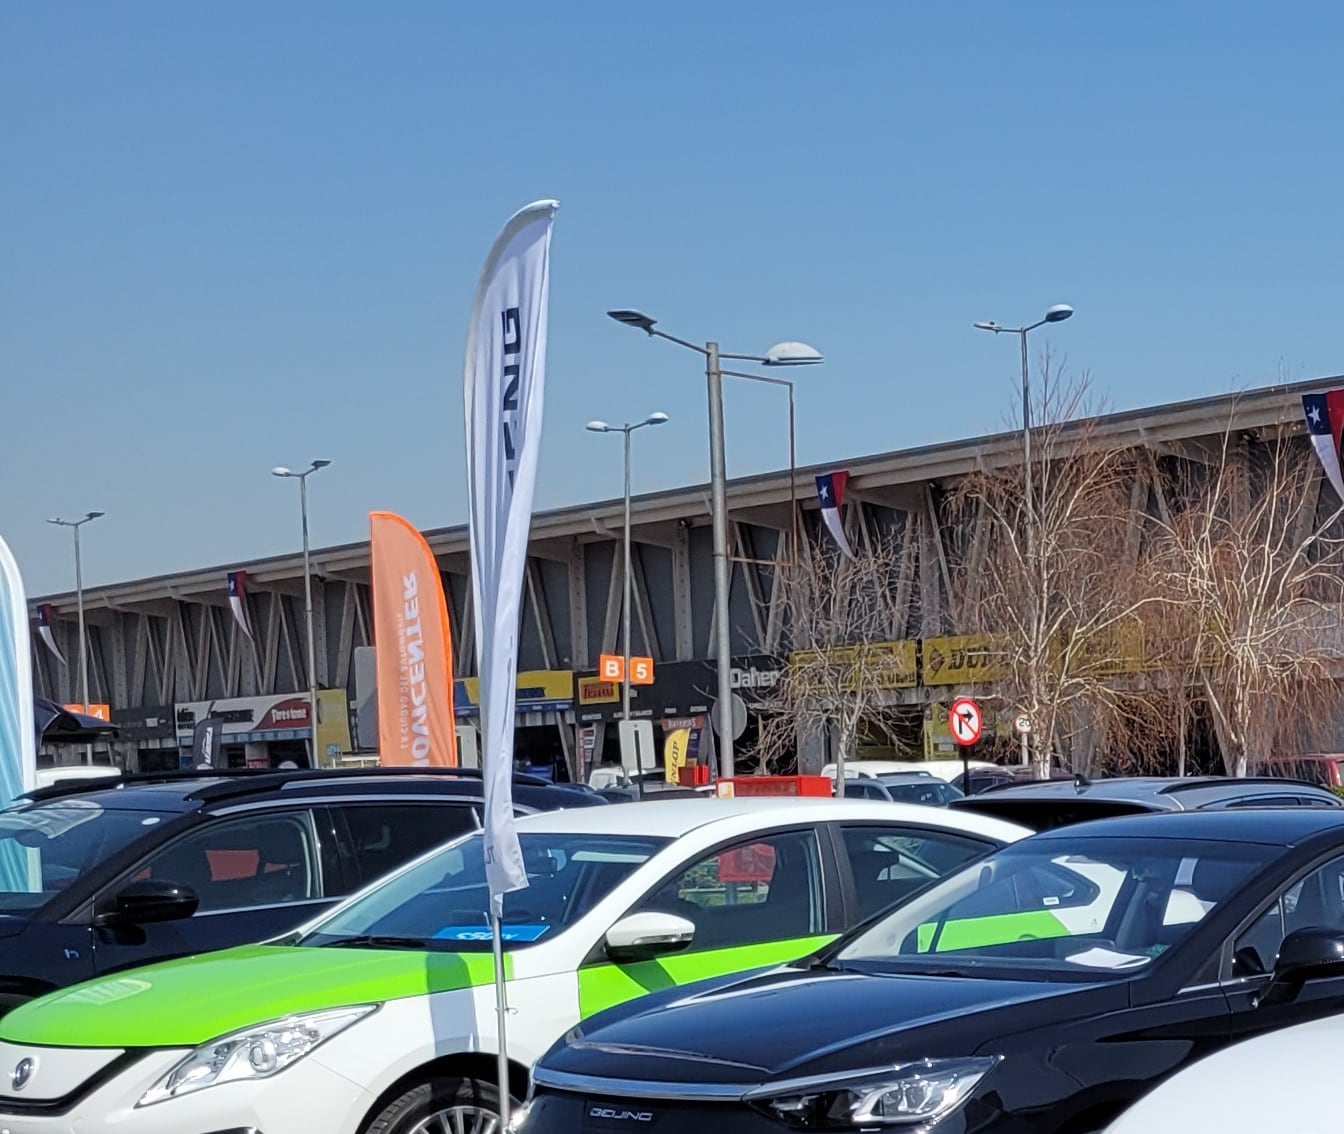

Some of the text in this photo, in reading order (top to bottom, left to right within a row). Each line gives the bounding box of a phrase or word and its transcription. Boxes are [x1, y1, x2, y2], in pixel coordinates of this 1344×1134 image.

[605, 660, 647, 679] B 5
[589, 1107, 653, 1122] BEIJING
